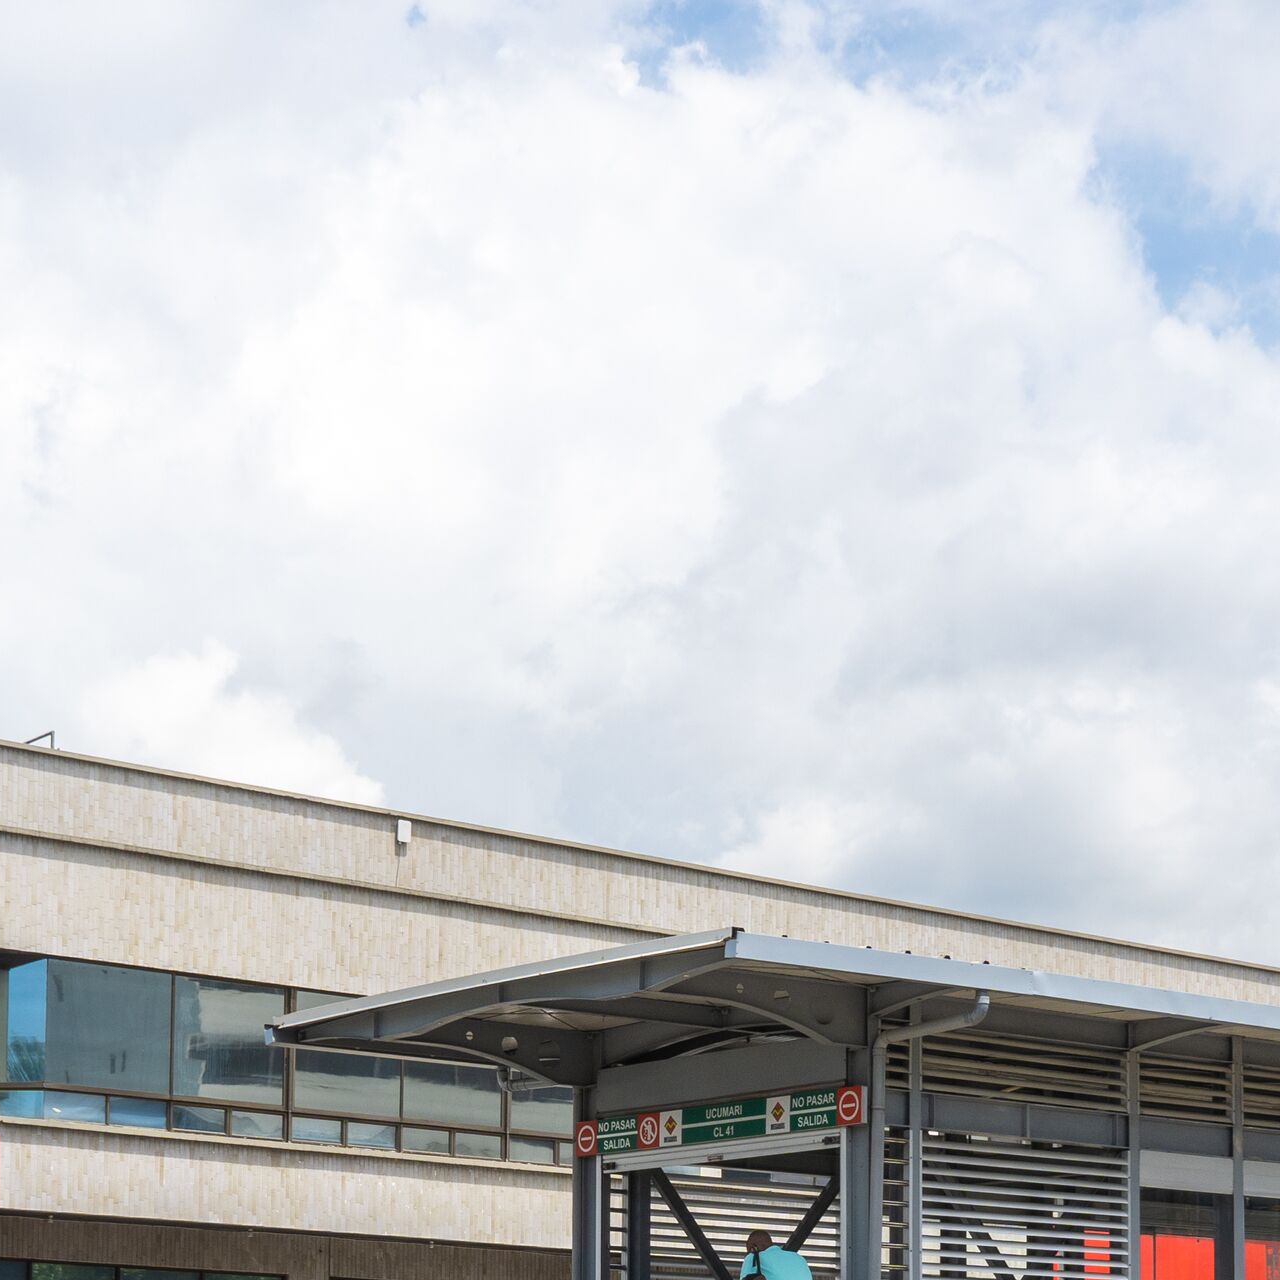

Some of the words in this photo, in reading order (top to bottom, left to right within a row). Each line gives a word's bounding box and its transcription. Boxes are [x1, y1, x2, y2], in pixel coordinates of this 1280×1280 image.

[791, 1096, 804, 1109] NO
[806, 1092, 835, 1107] PASAR
[705, 1105, 743, 1119] UCUMARI
[598, 1121, 609, 1132] NO
[610, 1118, 637, 1131] PASAR
[797, 1114, 829, 1128] SALIDA
[713, 1127, 724, 1138] CL
[725, 1126, 735, 1137] 41
[603, 1138, 631, 1150] SALIDA
